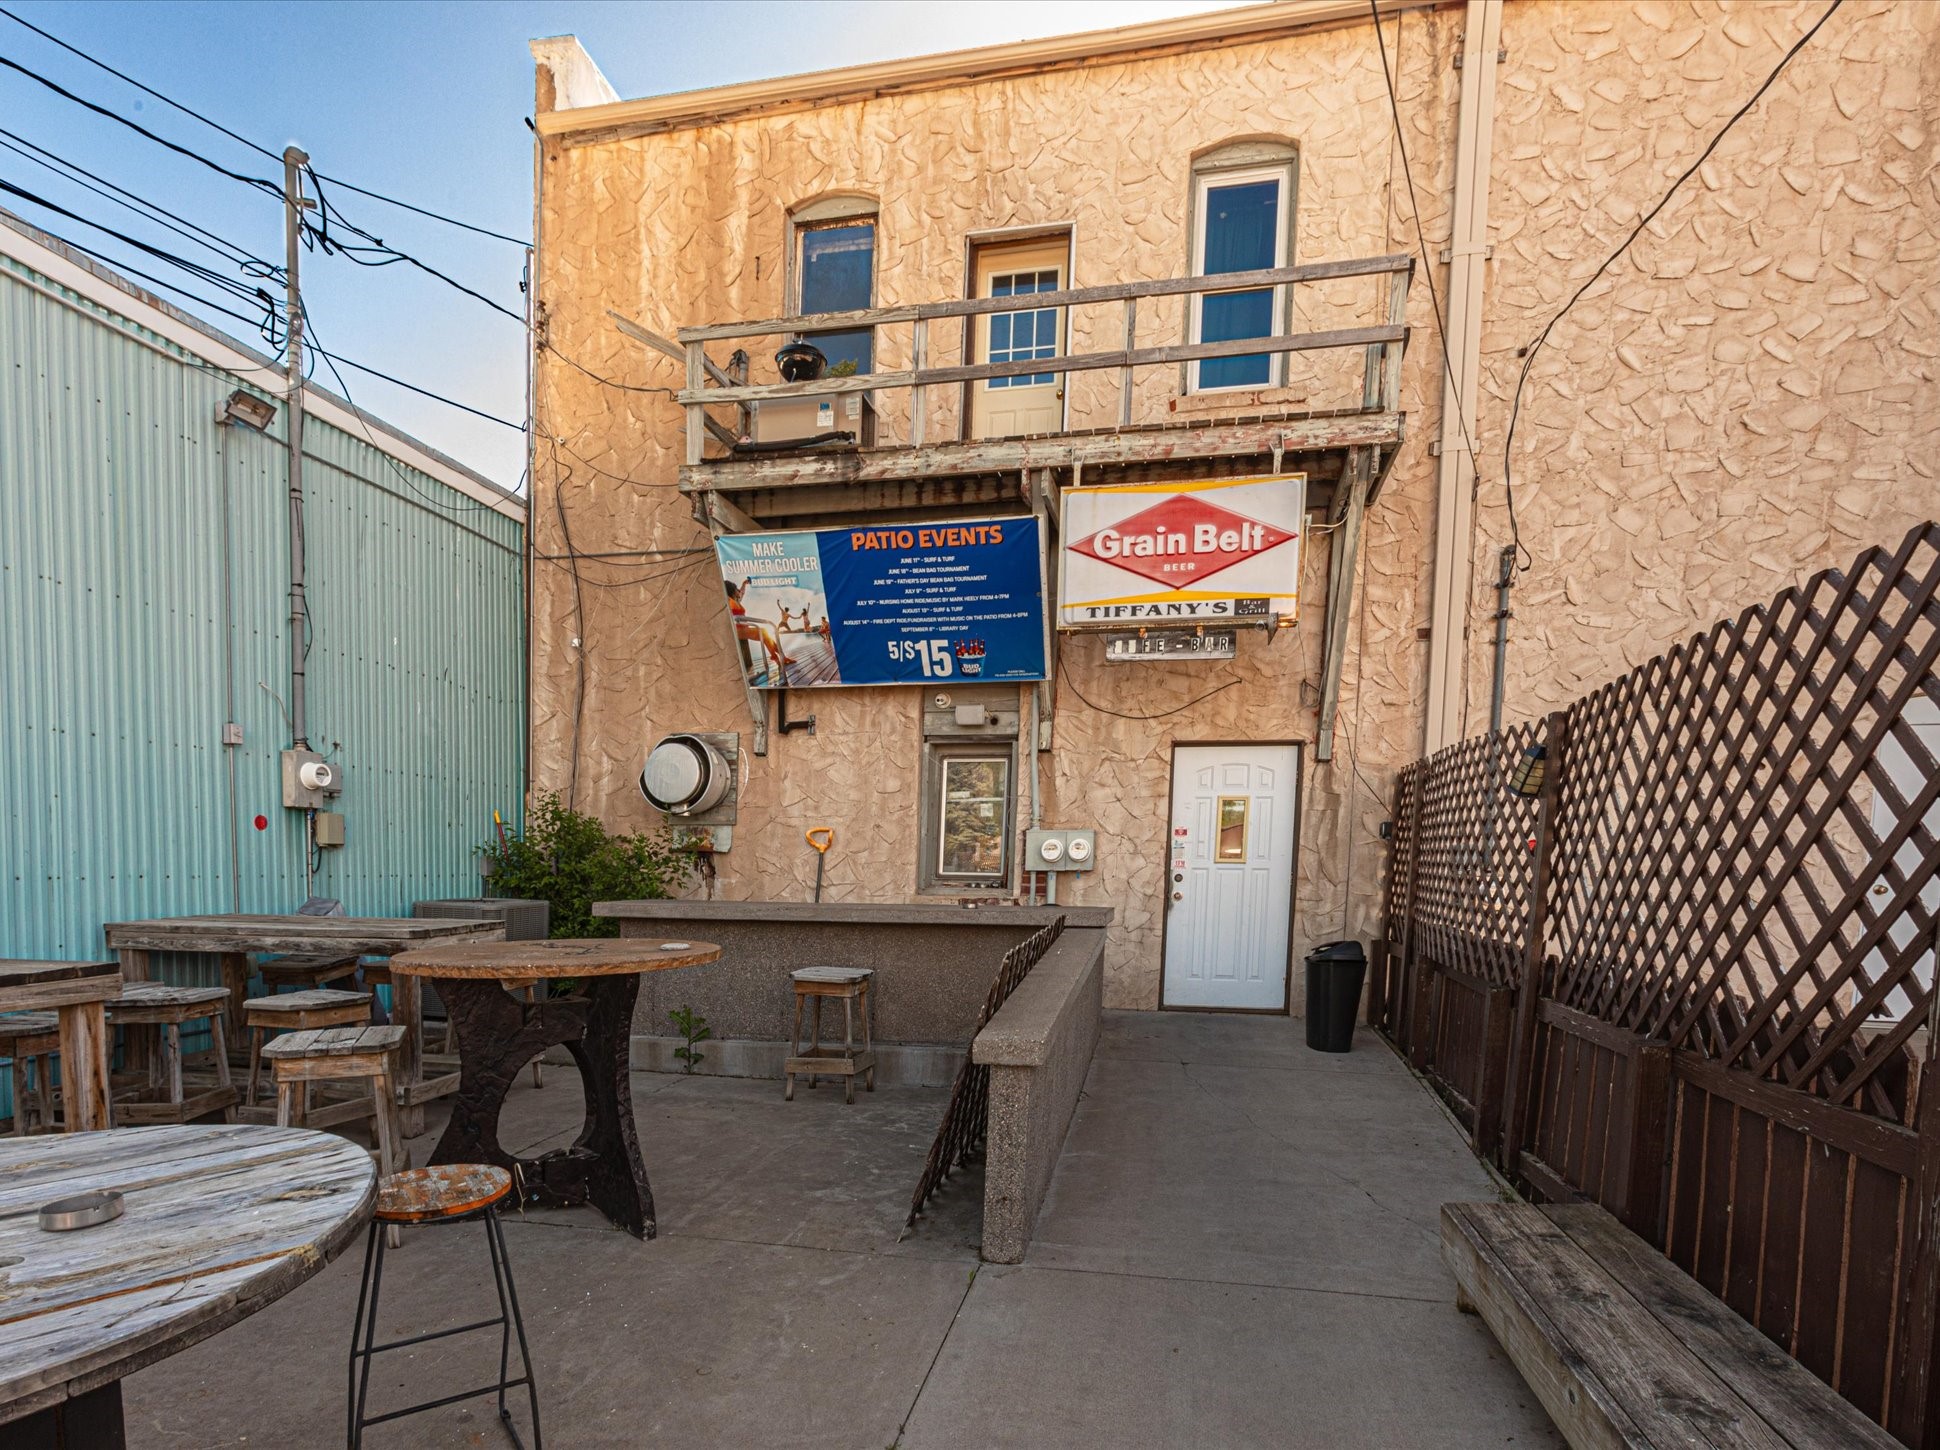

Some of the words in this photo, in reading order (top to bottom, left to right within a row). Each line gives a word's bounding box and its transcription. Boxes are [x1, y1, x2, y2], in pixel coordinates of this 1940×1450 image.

[851, 530, 914, 551] PATIO
[918, 525, 1003, 548] EVENTS
[1093, 526, 1186, 559] Grain
[1192, 522, 1265, 553] Belt
[752, 542, 784, 557] MAKE
[726, 559, 772, 574] SUMMER
[774, 556, 818, 572] COOLER
[1164, 562, 1196, 572] BEER
[770, 577, 797, 585] LIGHT
[1086, 601, 1228, 618] TIFFANY'S
[1190, 637, 1229, 652] BAR
